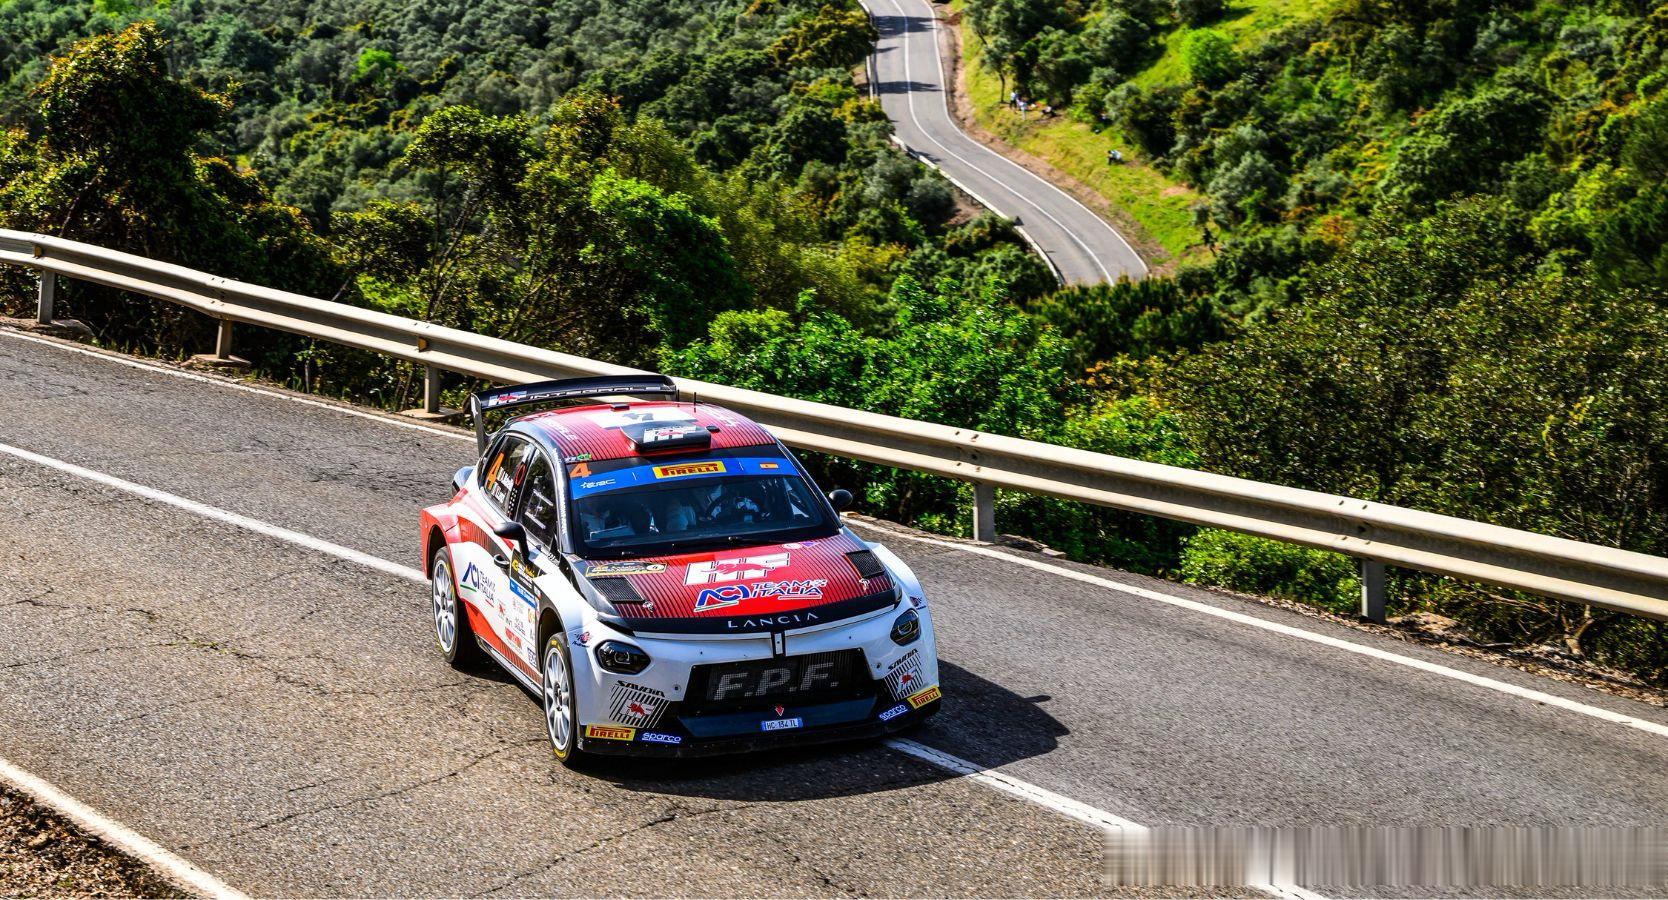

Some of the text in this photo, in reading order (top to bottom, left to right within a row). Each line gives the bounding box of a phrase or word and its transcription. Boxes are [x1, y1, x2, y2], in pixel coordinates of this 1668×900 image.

[570, 462, 592, 478] 4
[660, 463, 718, 476] PIRELLI
[751, 579, 812, 591] TEAM
[752, 586, 824, 598] ITALIA
[728, 612, 819, 628] LANCIA
[615, 680, 666, 697] SAVOIA
[714, 662, 840, 700] F.P.F.
[910, 687, 938, 707] PIRELLI
[878, 704, 908, 721] sparco
[590, 726, 631, 739] PIRELLI
[641, 732, 682, 743] sparco
